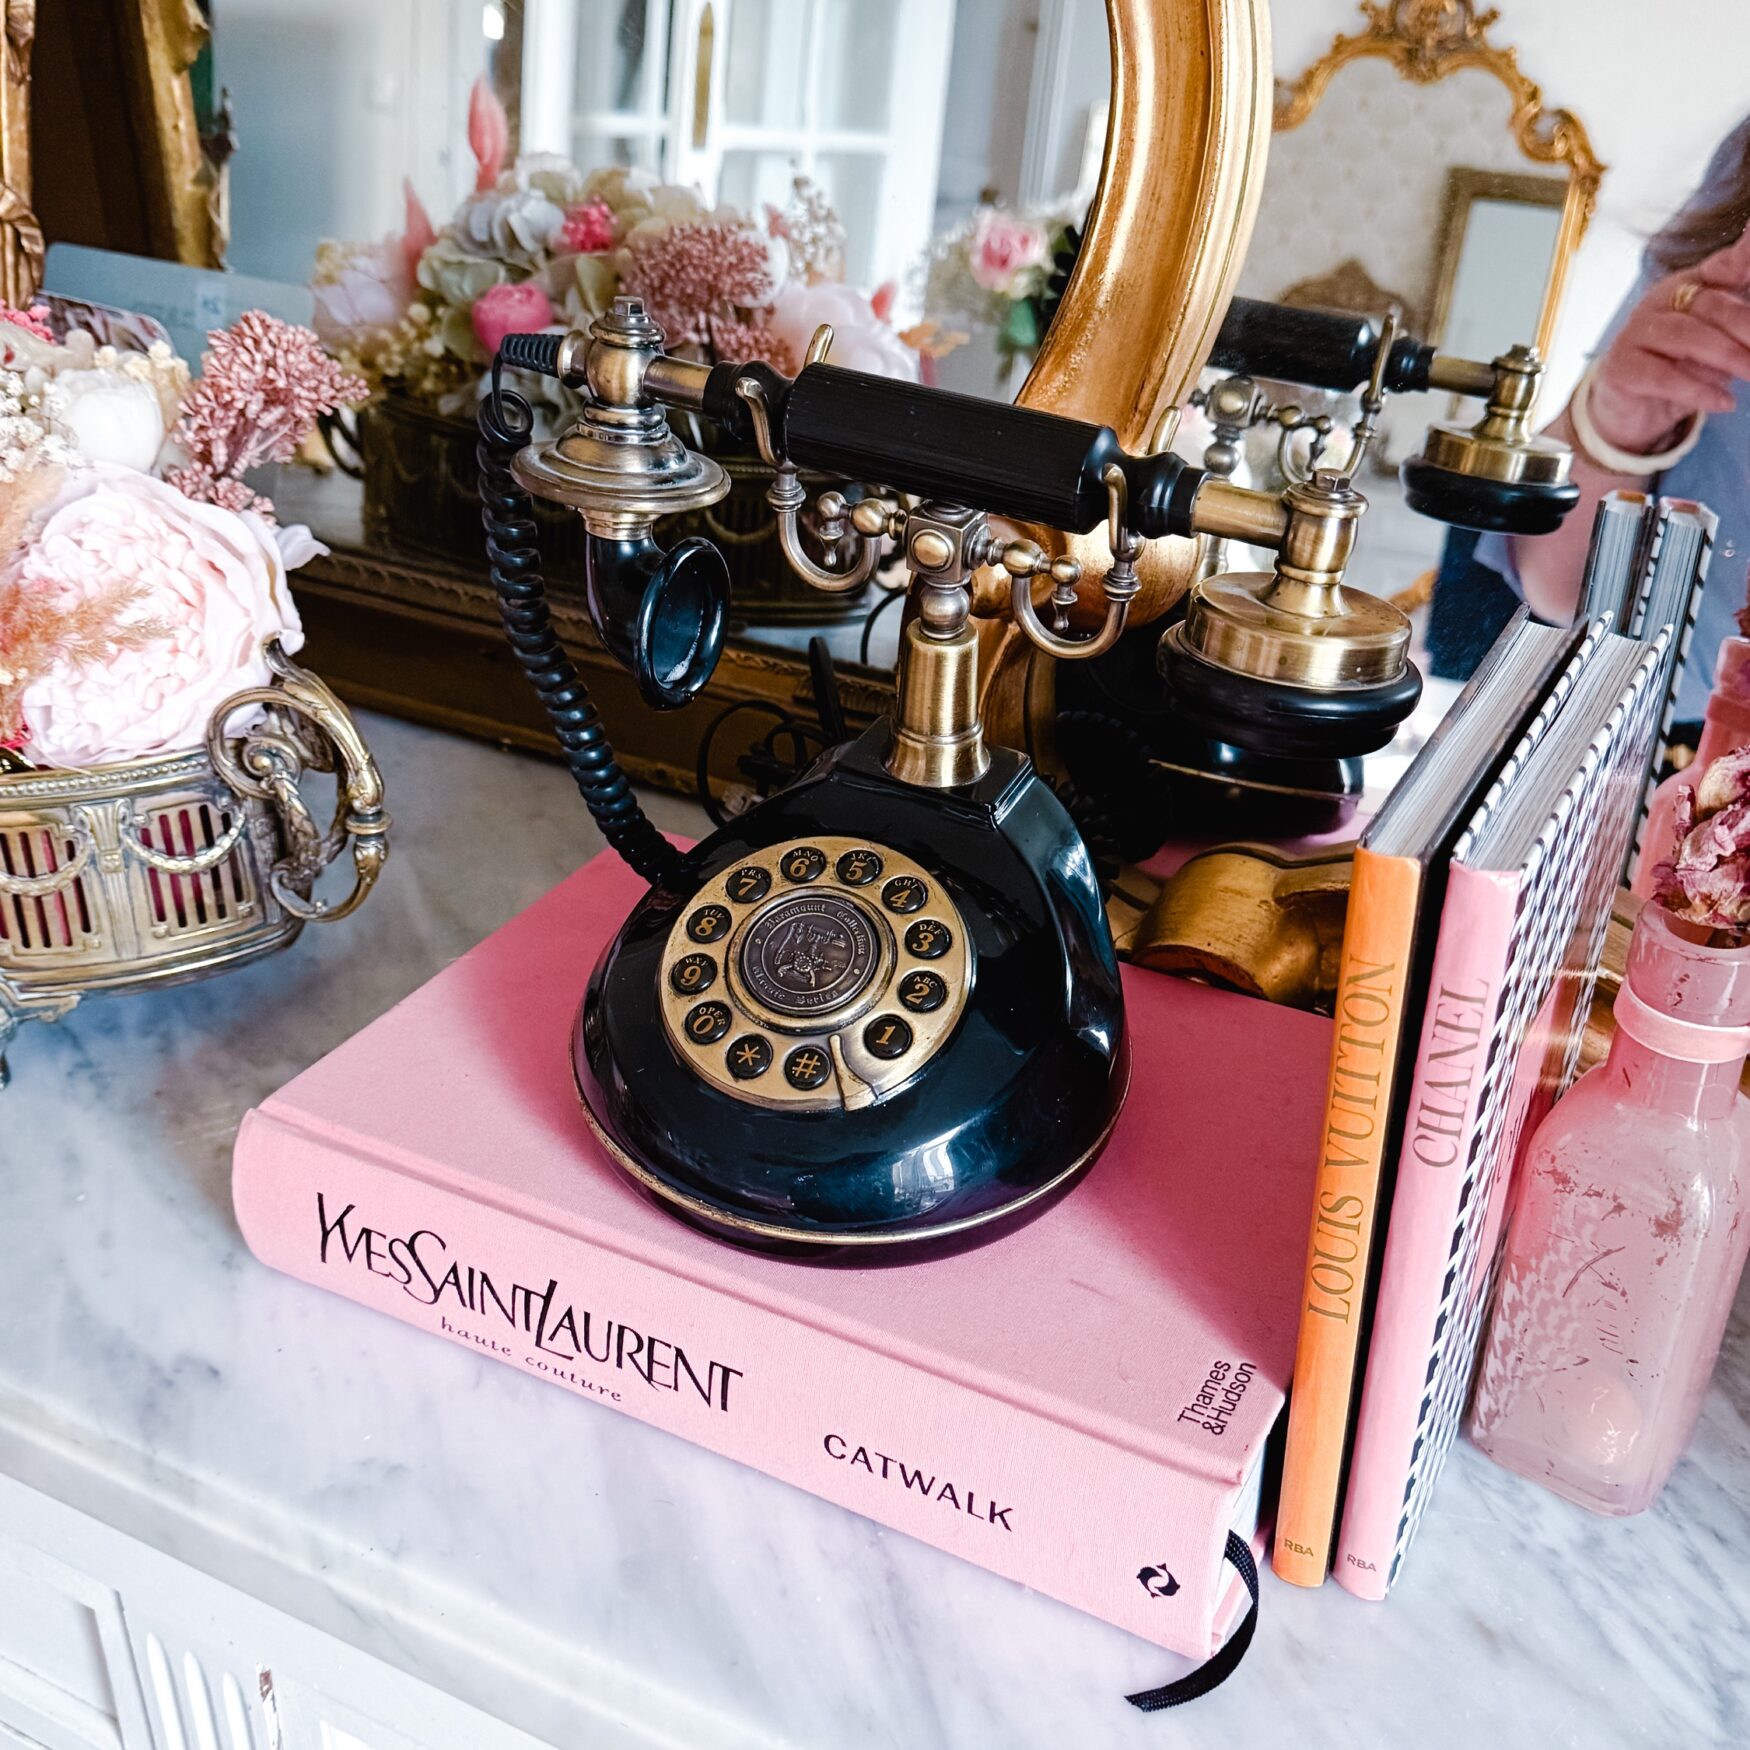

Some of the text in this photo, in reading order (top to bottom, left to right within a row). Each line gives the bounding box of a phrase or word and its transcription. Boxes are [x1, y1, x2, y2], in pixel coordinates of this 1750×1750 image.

[793, 850, 818, 861] MNO
[741, 869, 763, 880] PRS
[790, 858, 809, 877] 6
[846, 861, 868, 880] 5
[737, 877, 757, 896] 7
[894, 879, 919, 889] GHI
[890, 889, 911, 908] 4
[704, 908, 726, 919] TUV
[695, 916, 717, 936] 8
[920, 922, 943, 935] DEF
[912, 933, 934, 952] 3
[680, 965, 702, 986] 9
[914, 976, 938, 988] ABC
[905, 983, 930, 1005] 2
[693, 1015, 714, 1034] 0
[699, 1007, 726, 1026] OPER
[876, 1026, 896, 1044] 1
[792, 1053, 821, 1079] #
[1412, 978, 1490, 1169] CHANEL
[1308, 958, 1396, 1324] LOUIS VUITTON
[440, 1315, 622, 1402] haute couture
[1177, 1360, 1231, 1424] Thames
[1202, 1362, 1257, 1435] &Hudson
[823, 1434, 1013, 1532] CATWALK
[1284, 1538, 1314, 1557] RBA
[1347, 1553, 1377, 1572] RBA
